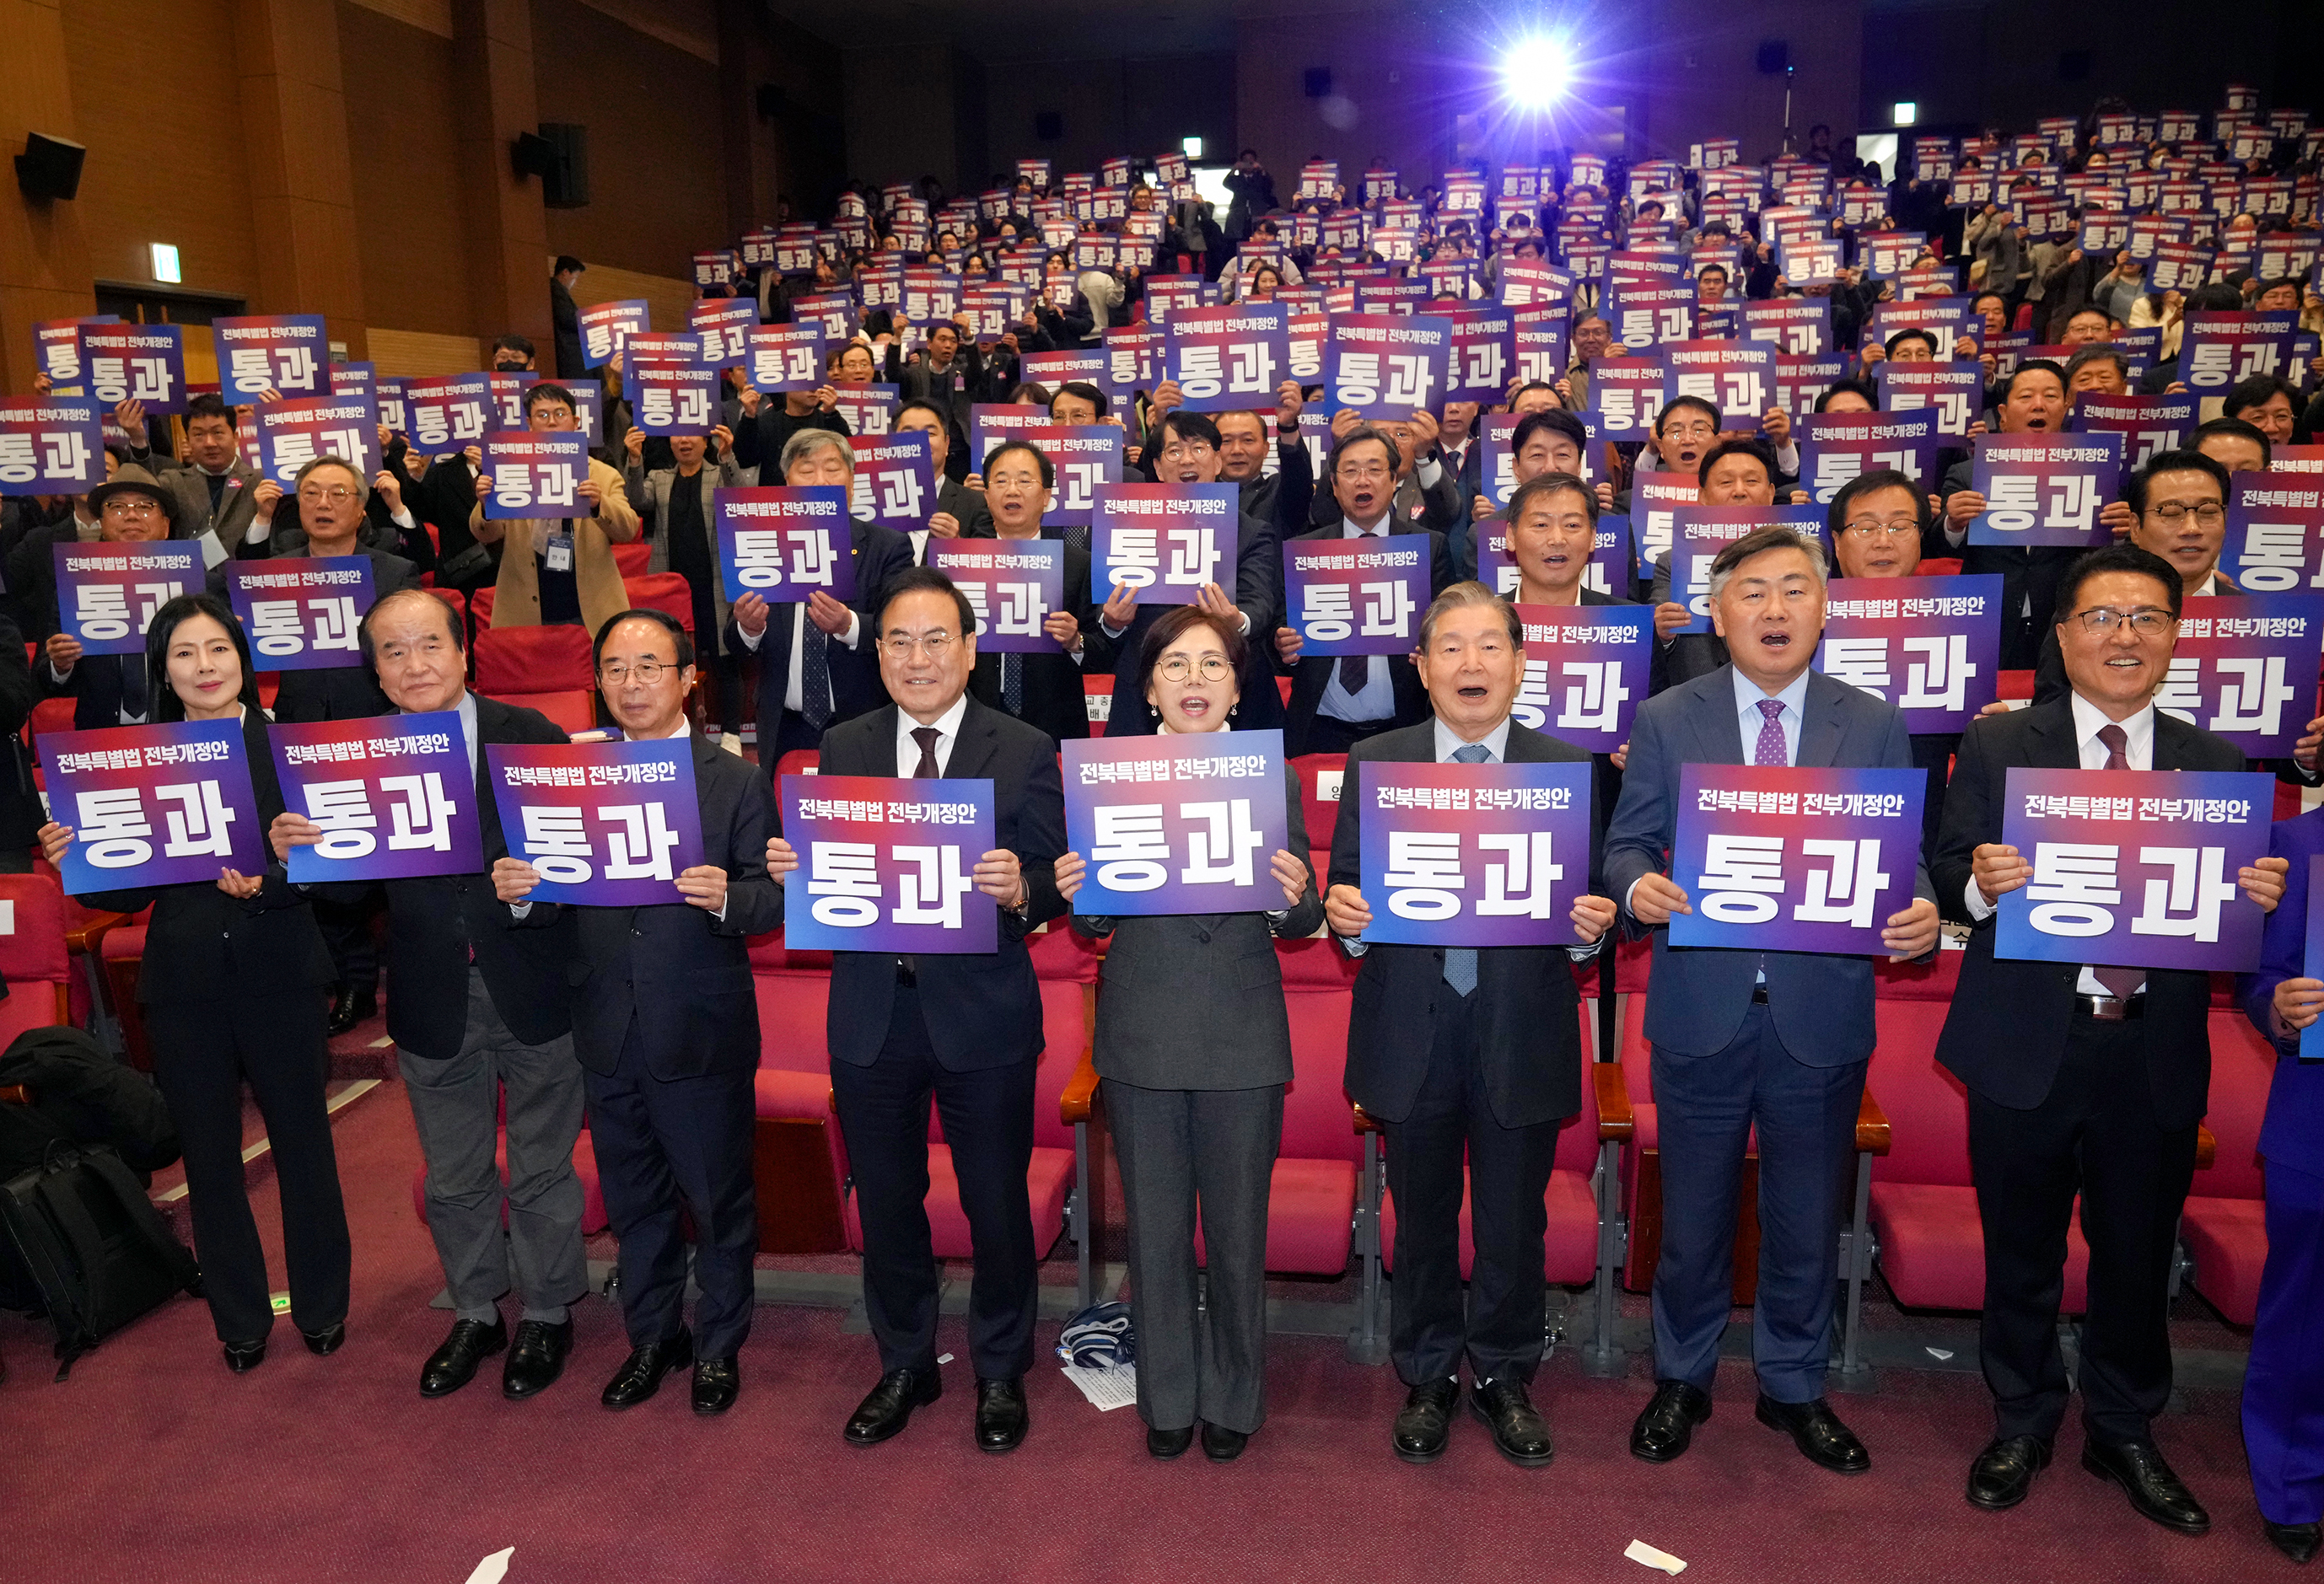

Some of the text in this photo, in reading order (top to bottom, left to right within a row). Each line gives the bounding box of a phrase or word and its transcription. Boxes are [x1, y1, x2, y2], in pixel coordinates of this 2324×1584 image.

[2027, 211, 2070, 235] 통과
[1788, 255, 1837, 281] 통과
[1875, 249, 1918, 274] 통과
[2153, 260, 2204, 289] 통과
[2259, 251, 2314, 279] 통과
[906, 293, 956, 319] 통과
[1622, 307, 1692, 347] 통과
[231, 347, 318, 399] 통과
[754, 346, 817, 384] 통과
[1179, 342, 1275, 398] 통과
[2190, 343, 2280, 386] 통과
[93, 358, 173, 401] 통과
[1336, 353, 1434, 407] 통과
[36, 409, 90, 421] 전부개정안
[642, 389, 712, 426] 통과
[415, 401, 487, 444] 통과
[1812, 422, 1928, 440] 전북특별법 전부개정안
[0, 432, 91, 482] 통과
[1986, 448, 2110, 462] 전북특별법 전부개정안
[2271, 460, 2324, 473] 전북특별
[494, 464, 578, 507] 통과
[1643, 485, 1698, 501] 전북특별법
[2242, 491, 2319, 507] 전북특별법
[725, 502, 837, 517] 전북특별법 전부개정안
[1105, 500, 1226, 513] 전북특별법 전부개정안
[1986, 475, 2101, 530] 통과
[66, 556, 191, 571] 전북특별법 전부개정안
[734, 529, 837, 588] 통과
[938, 554, 1052, 569] 전북특별법 전부개정안
[1106, 529, 1220, 588] 통과
[1295, 551, 1418, 570] 전북특별법 전부개정안
[239, 571, 361, 589] 전북특별법 전부개정안
[1302, 580, 1415, 641] 통과
[1826, 597, 1985, 619] 북특별법 전부개정안
[251, 597, 363, 655] 통과
[1562, 626, 1638, 643] 전부개정안
[2216, 618, 2306, 637] 전부개정안
[57, 741, 229, 773] 전북특별법 전부개정안
[285, 733, 449, 764] 전북특별법 전부개정안
[504, 761, 676, 786] 전북특별법 전부개정안
[1080, 755, 1266, 784] 전북특별법 전부개정안
[799, 799, 976, 824] 전북특별법 전부개정안
[1377, 787, 1571, 809] 전북특별법 전부개정안
[1698, 789, 1904, 816] 전북특별법 전부개정안
[2025, 795, 2251, 823] 전북특별법 전부개정안
[76, 780, 235, 867] 통과
[301, 772, 456, 858] 통과
[517, 802, 679, 883] 통과
[1092, 799, 1263, 891] 통과
[808, 841, 971, 928] 통과
[1385, 832, 1563, 920] 통과
[1698, 835, 1890, 927] 통과
[2026, 842, 2235, 942] 통과
